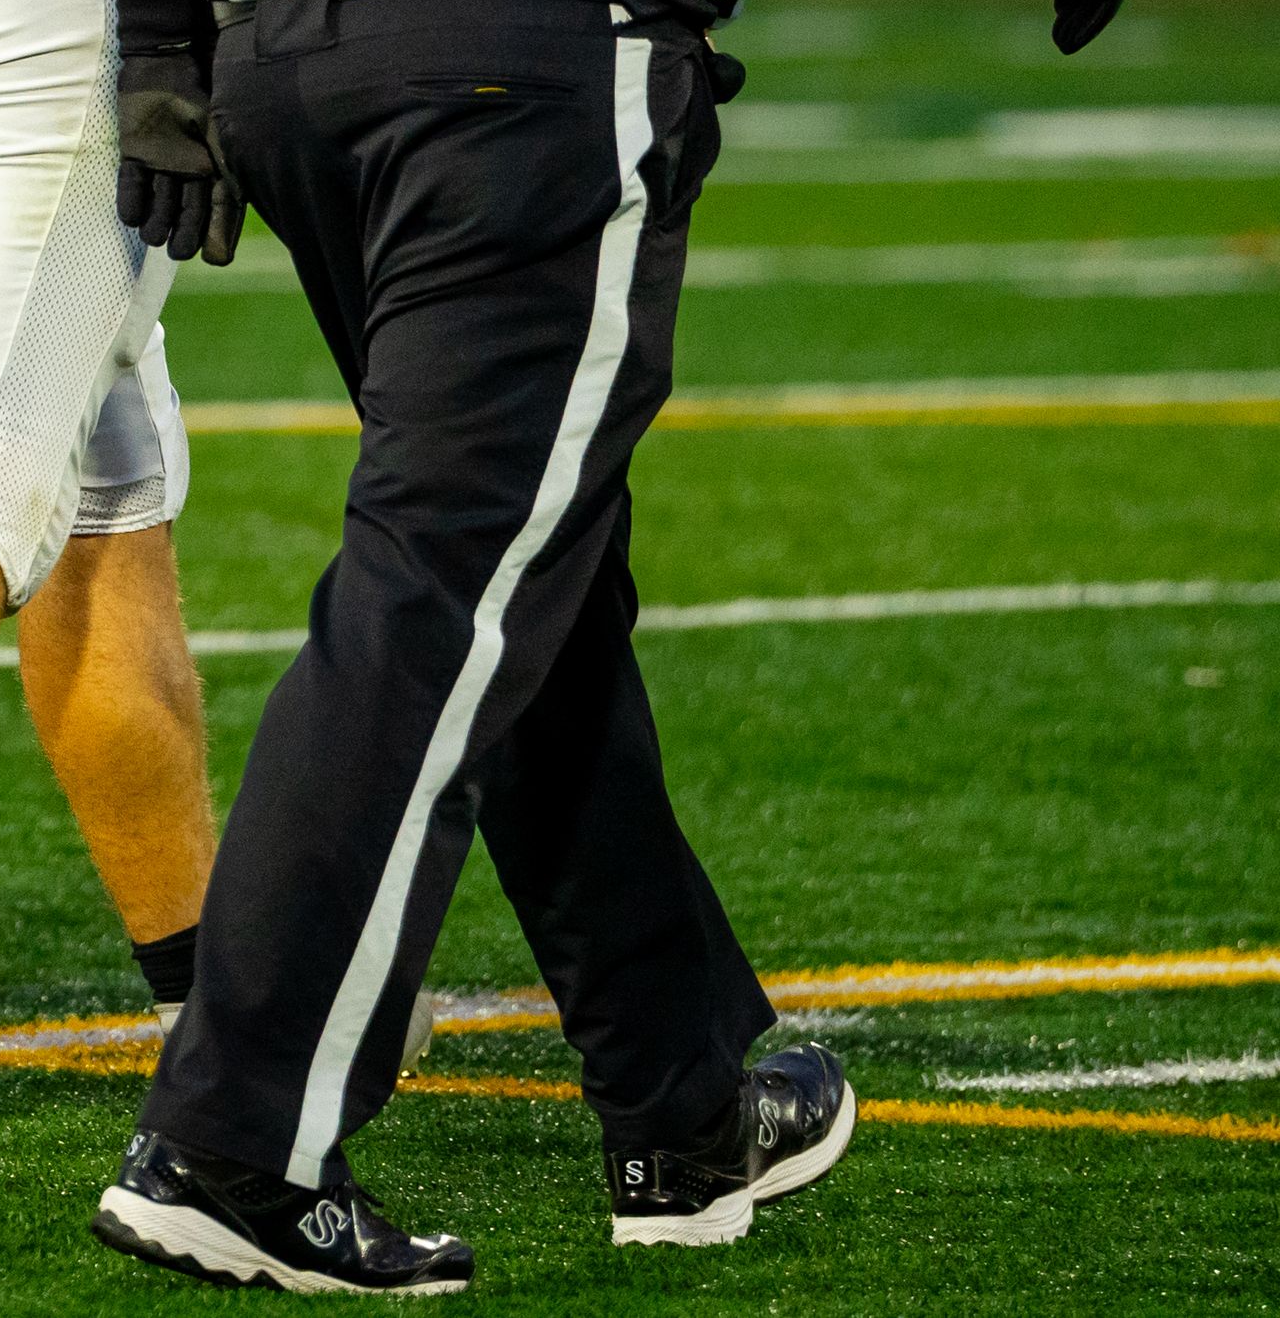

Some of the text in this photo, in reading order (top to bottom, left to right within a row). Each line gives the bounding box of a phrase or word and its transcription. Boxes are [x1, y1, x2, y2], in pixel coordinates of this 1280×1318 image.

[759, 1098, 780, 1149] S
[625, 1160, 644, 1184] S
[298, 1199, 351, 1248] S
